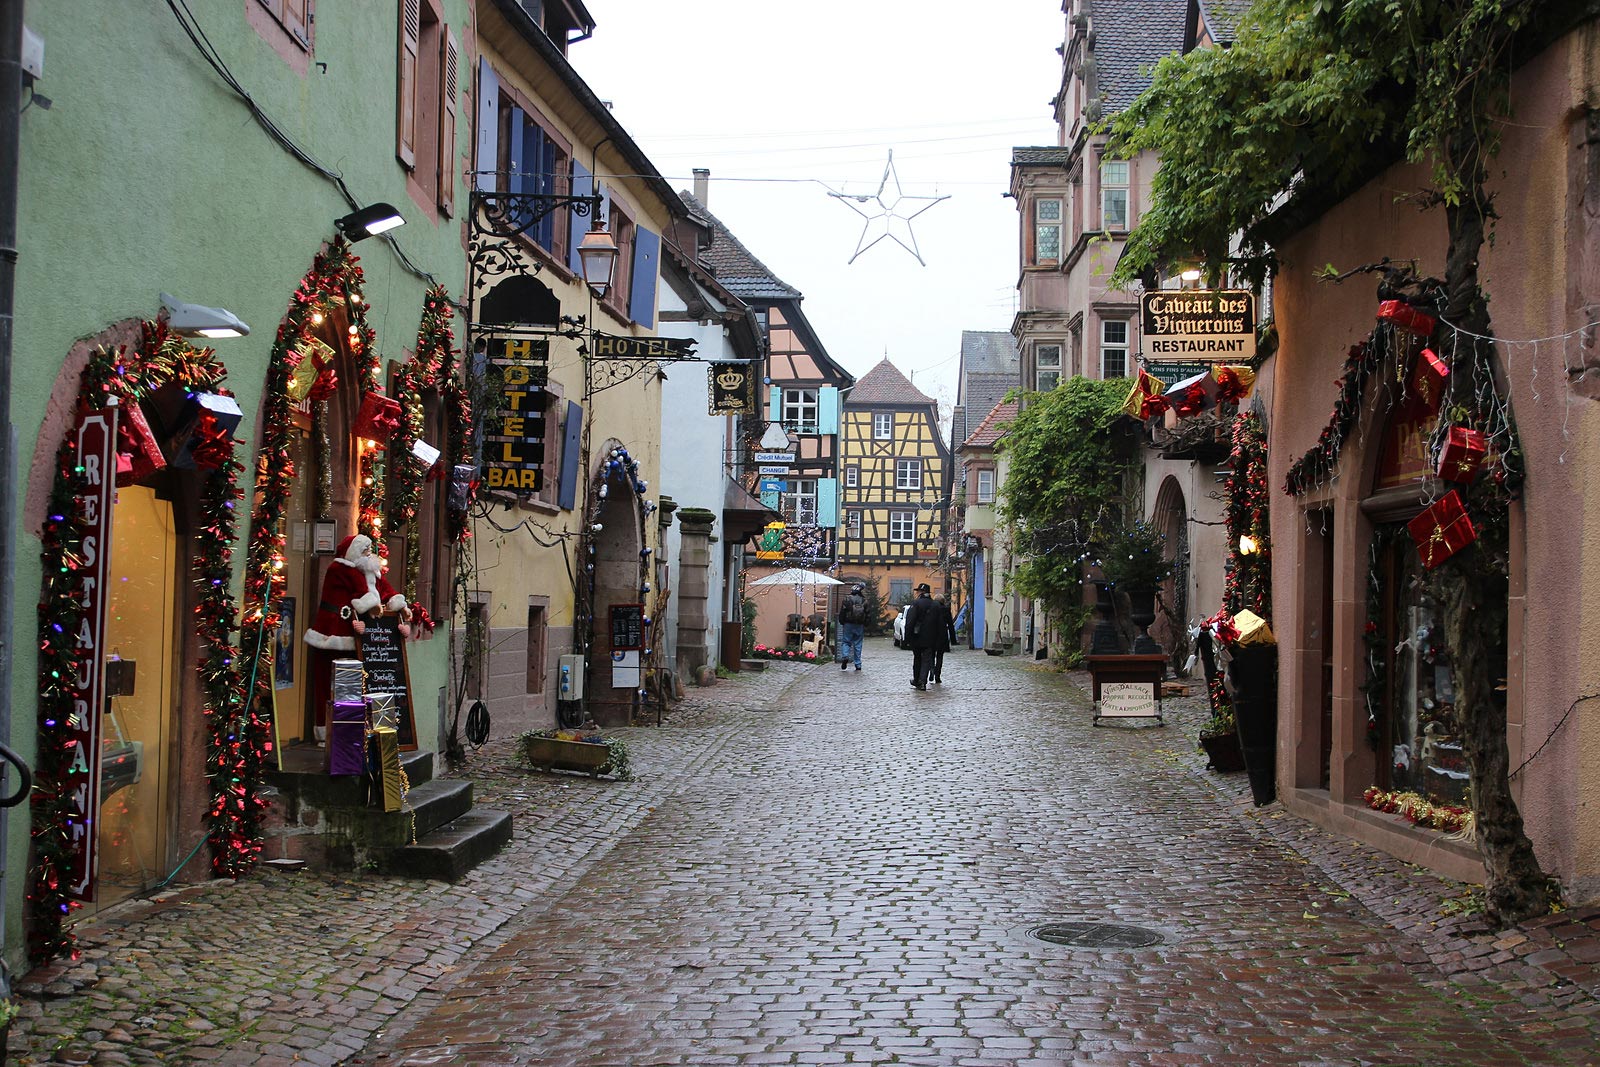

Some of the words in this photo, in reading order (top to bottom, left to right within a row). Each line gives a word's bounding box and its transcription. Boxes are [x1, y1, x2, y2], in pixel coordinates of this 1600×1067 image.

[1149, 296, 1213, 315] Caveau
[1218, 296, 1248, 314] des
[1153, 315, 1244, 335] Vignerons
[598, 338, 678, 356] HOTEL
[1152, 339, 1245, 353] RESTAURANT
[503, 340, 531, 462] HOTEL
[488, 468, 536, 489] BAR
